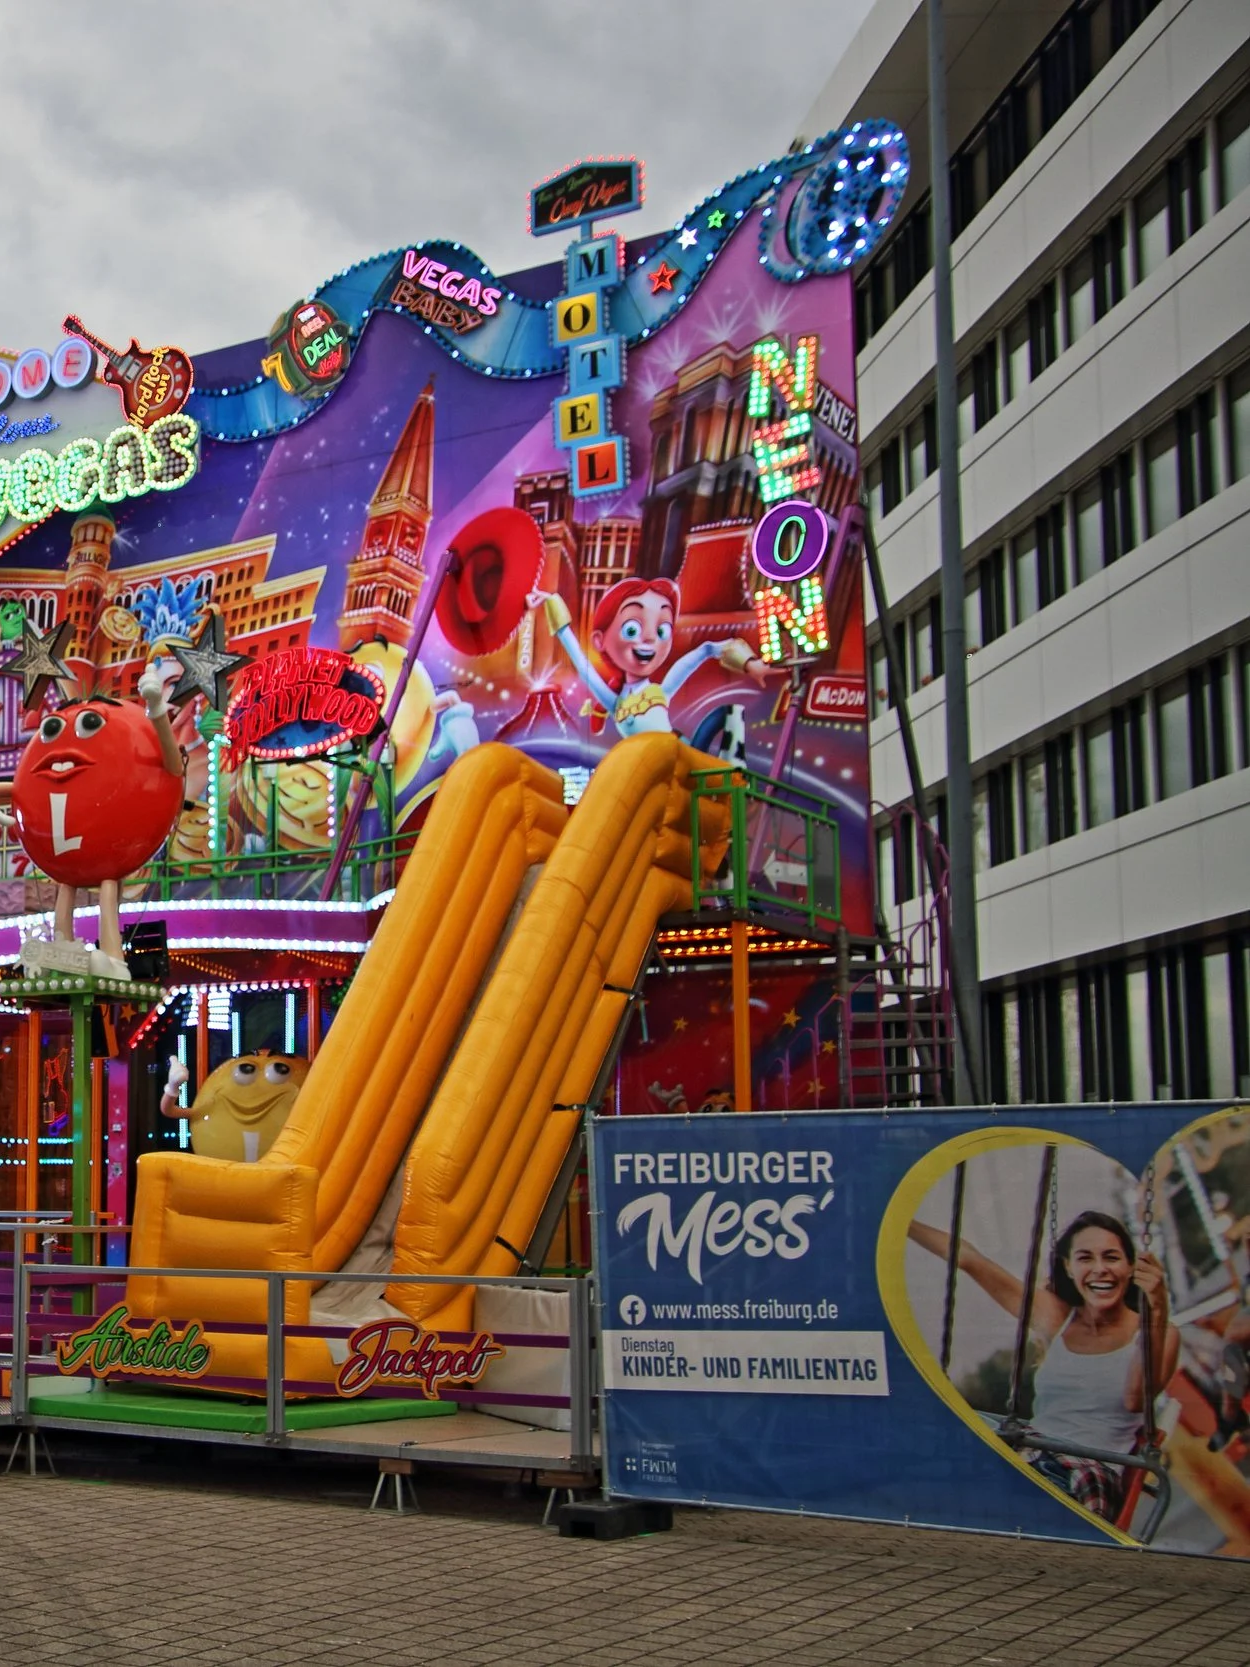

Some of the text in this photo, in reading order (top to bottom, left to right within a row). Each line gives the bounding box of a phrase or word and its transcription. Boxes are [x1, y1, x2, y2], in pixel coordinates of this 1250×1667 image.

[390, 279, 483, 335] BABY
[402, 250, 502, 316] VEGAS
[261, 352, 294, 392] 7
[303, 327, 343, 366] DEAL
[563, 247, 609, 484] MOTEL
[128, 347, 170, 430] Hard Rock
[749, 335, 830, 663] NEON
[240, 646, 352, 709] PLANET
[614, 1151, 834, 1184] FREIBURGER
[63, 1306, 212, 1374] Airslide
[652, 1299, 839, 1325] www.mess.freiburg.de
[339, 1320, 501, 1399] Jackpot
[621, 1336, 676, 1357] Dienstag
[623, 1356, 878, 1381] KINDER- UND FAMILIENTAG
[642, 1458, 677, 1474] FWTM
